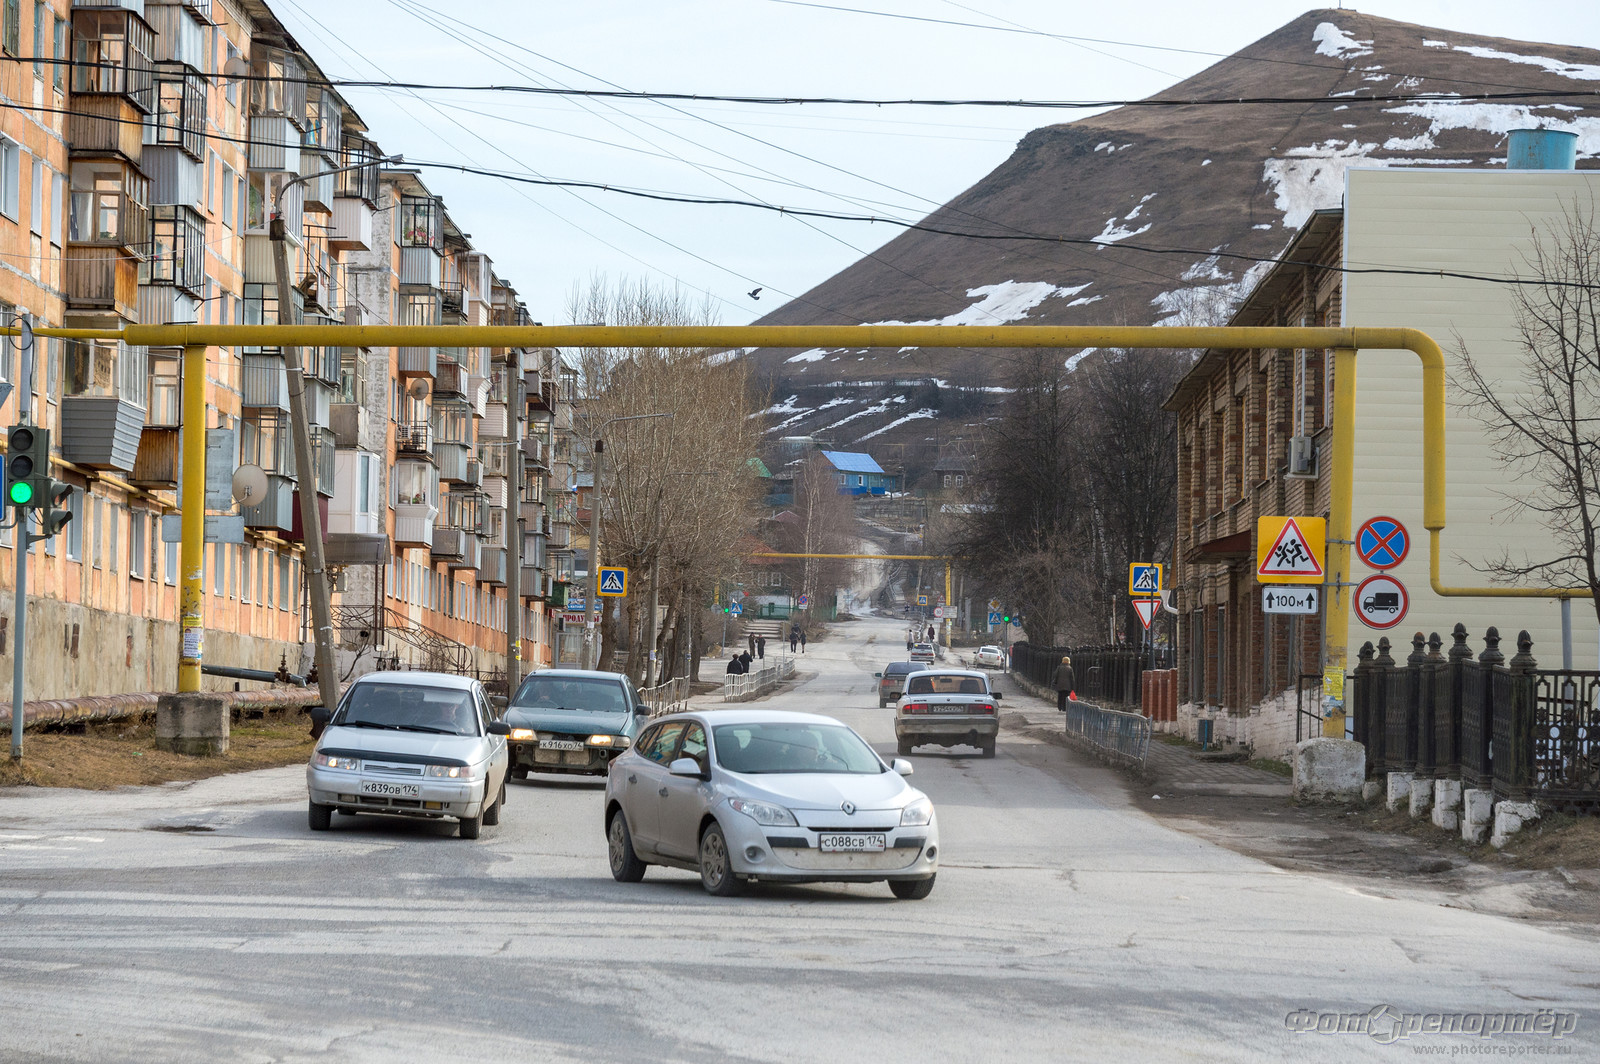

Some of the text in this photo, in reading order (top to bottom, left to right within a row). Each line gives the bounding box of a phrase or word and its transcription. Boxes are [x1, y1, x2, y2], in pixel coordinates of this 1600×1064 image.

[563, 614, 599, 622] ПРОДУЫ
[402, 785, 417, 794] 174
[824, 836, 883, 847] С088СВ 174
